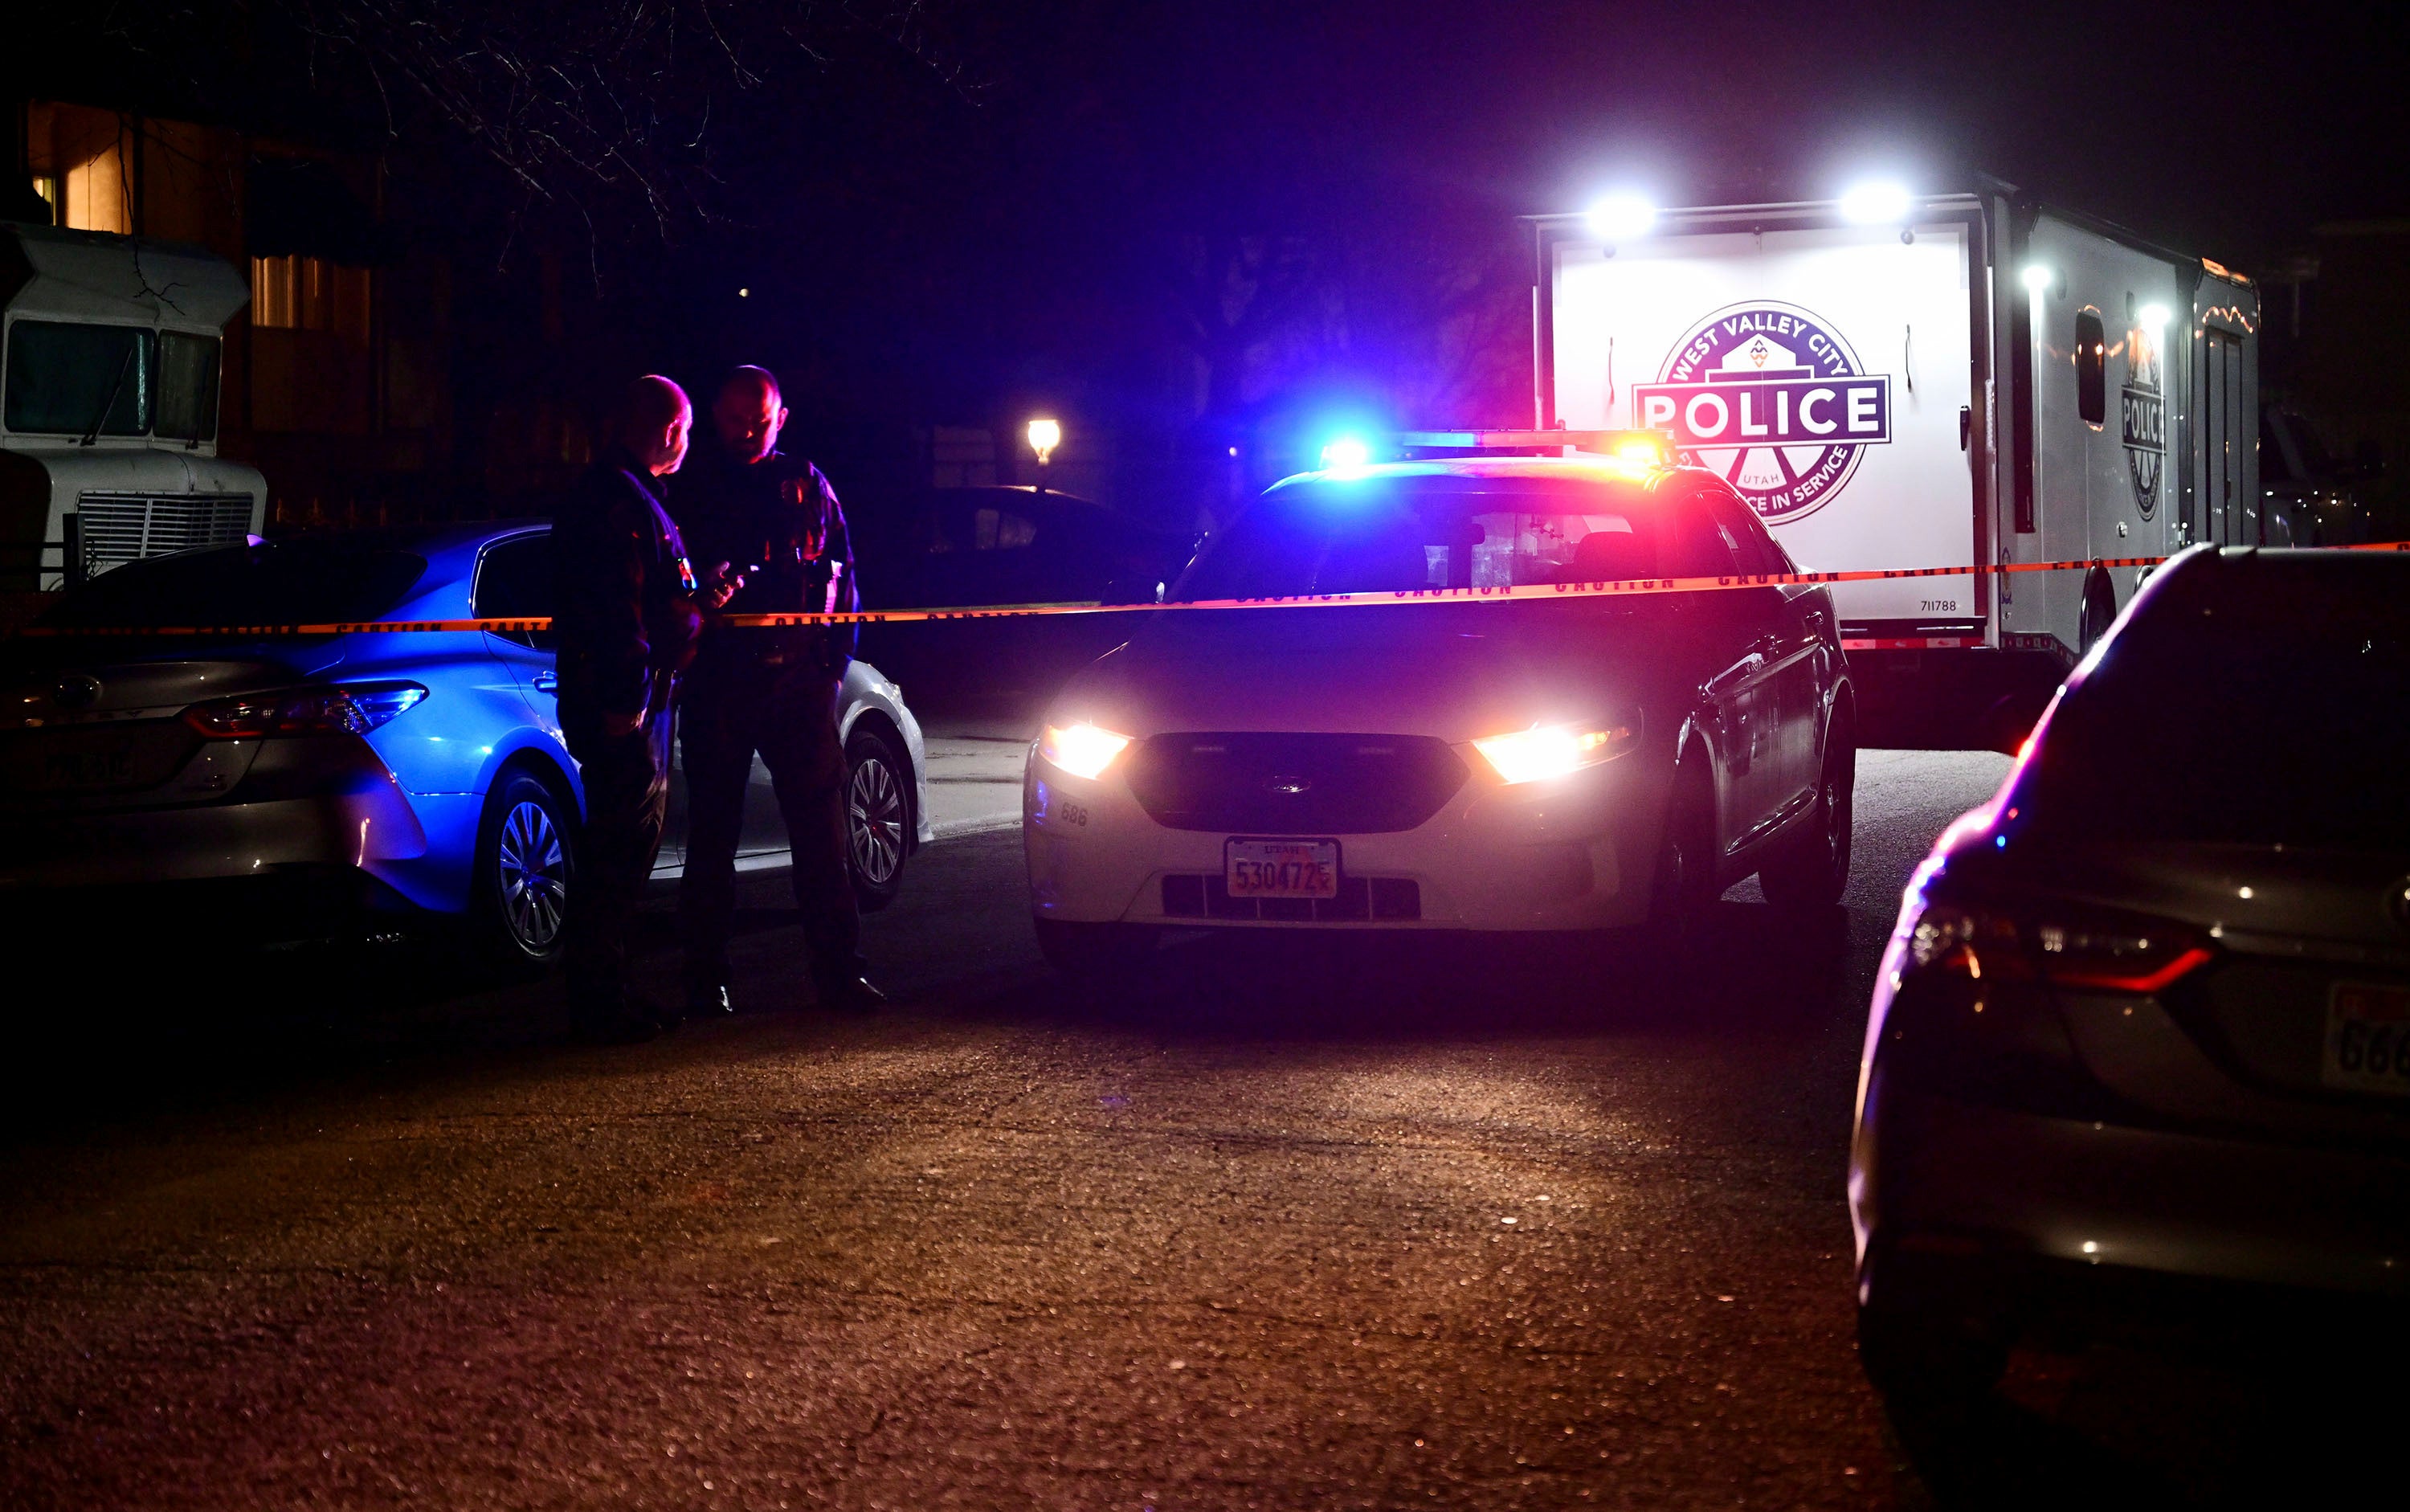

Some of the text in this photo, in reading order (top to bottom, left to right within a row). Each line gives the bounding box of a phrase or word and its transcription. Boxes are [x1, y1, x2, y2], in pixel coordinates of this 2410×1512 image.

[1673, 313, 1848, 381] WEST VALLEY CITY
[1644, 387, 1879, 439] POLICE
[2123, 398, 2164, 444] POLICE
[1743, 473, 1780, 485] UTAH
[1772, 491, 1791, 510] IN
[1795, 445, 1848, 502] SERVICE
[1921, 600, 1957, 611] 711788
